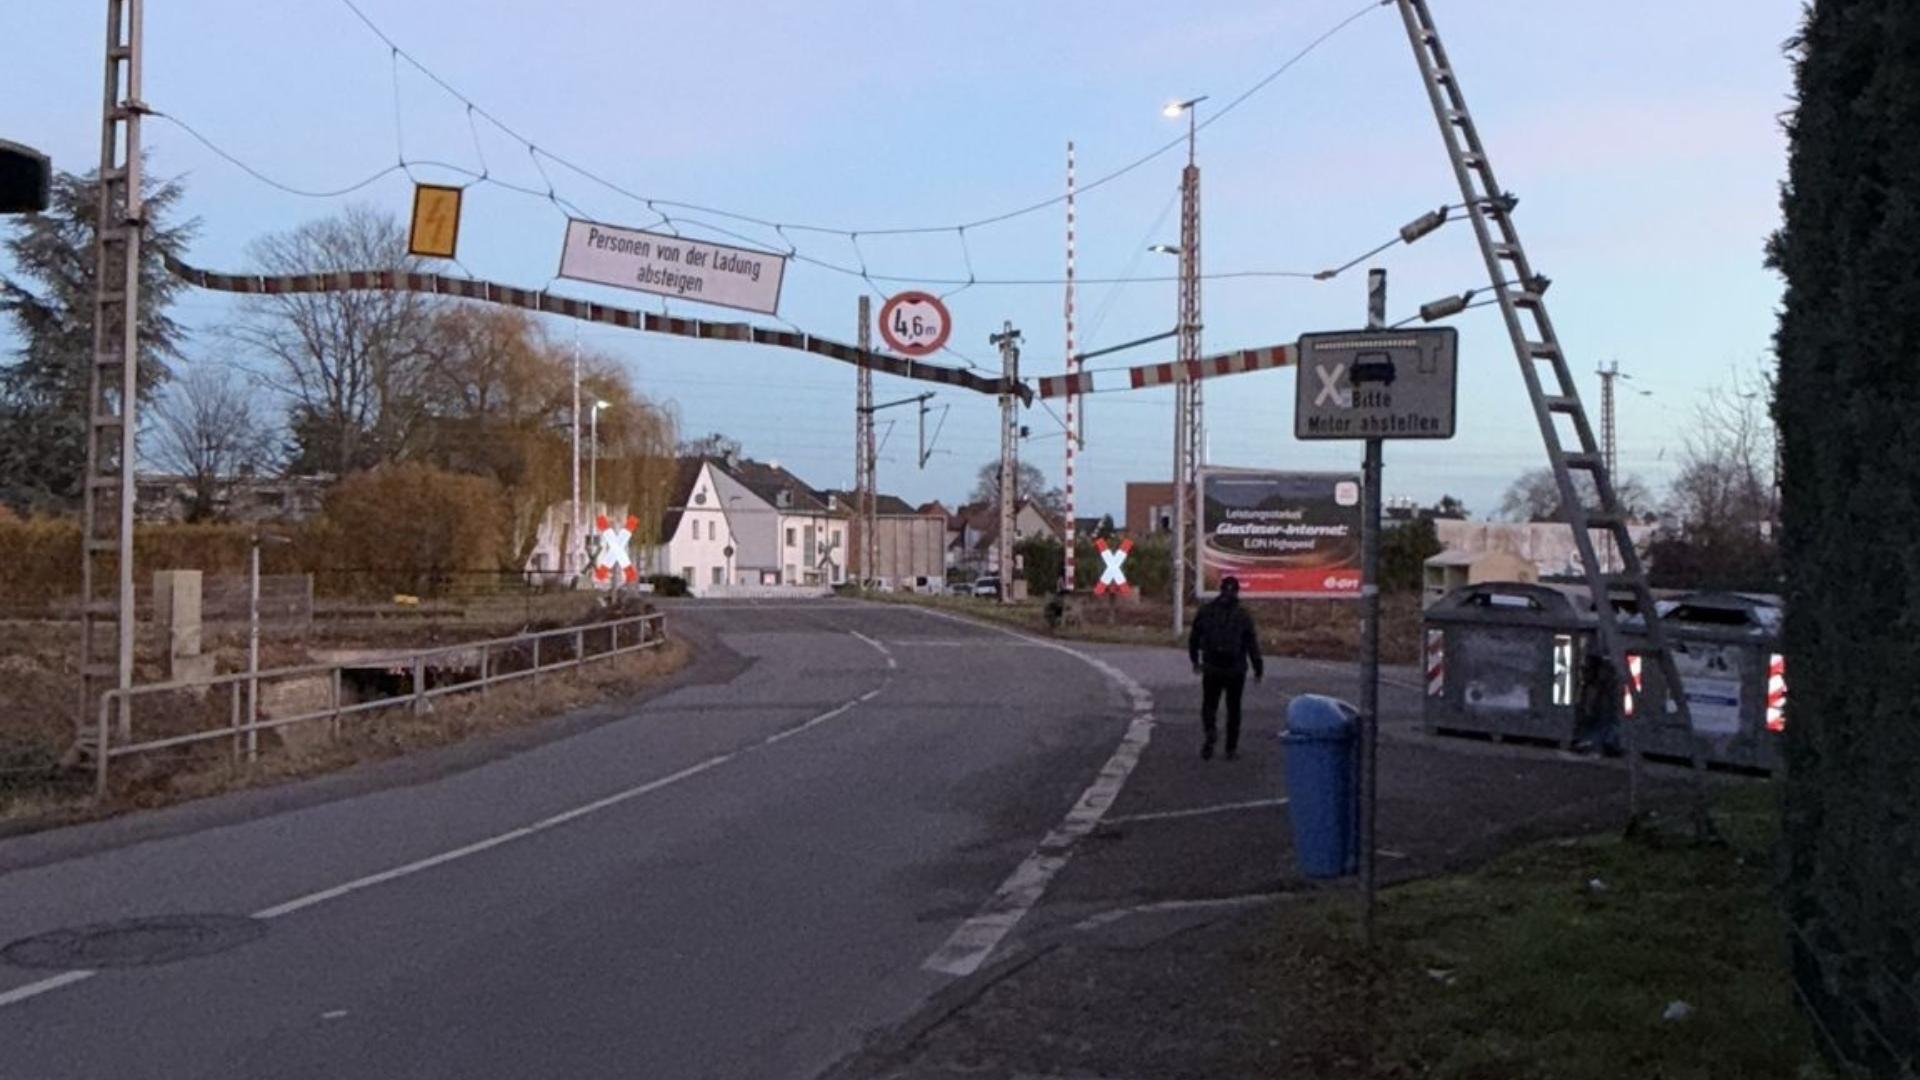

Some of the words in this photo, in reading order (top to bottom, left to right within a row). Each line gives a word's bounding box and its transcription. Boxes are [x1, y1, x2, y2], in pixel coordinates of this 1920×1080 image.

[588, 227, 651, 258] Personen
[657, 243, 680, 262] von
[686, 246, 707, 266] der
[713, 252, 761, 281] Ladung
[637, 265, 703, 293] absteigen
[1352, 391, 1392, 408] Bitte
[1308, 416, 1350, 432] Motor
[1360, 414, 1439, 431] abstellen
